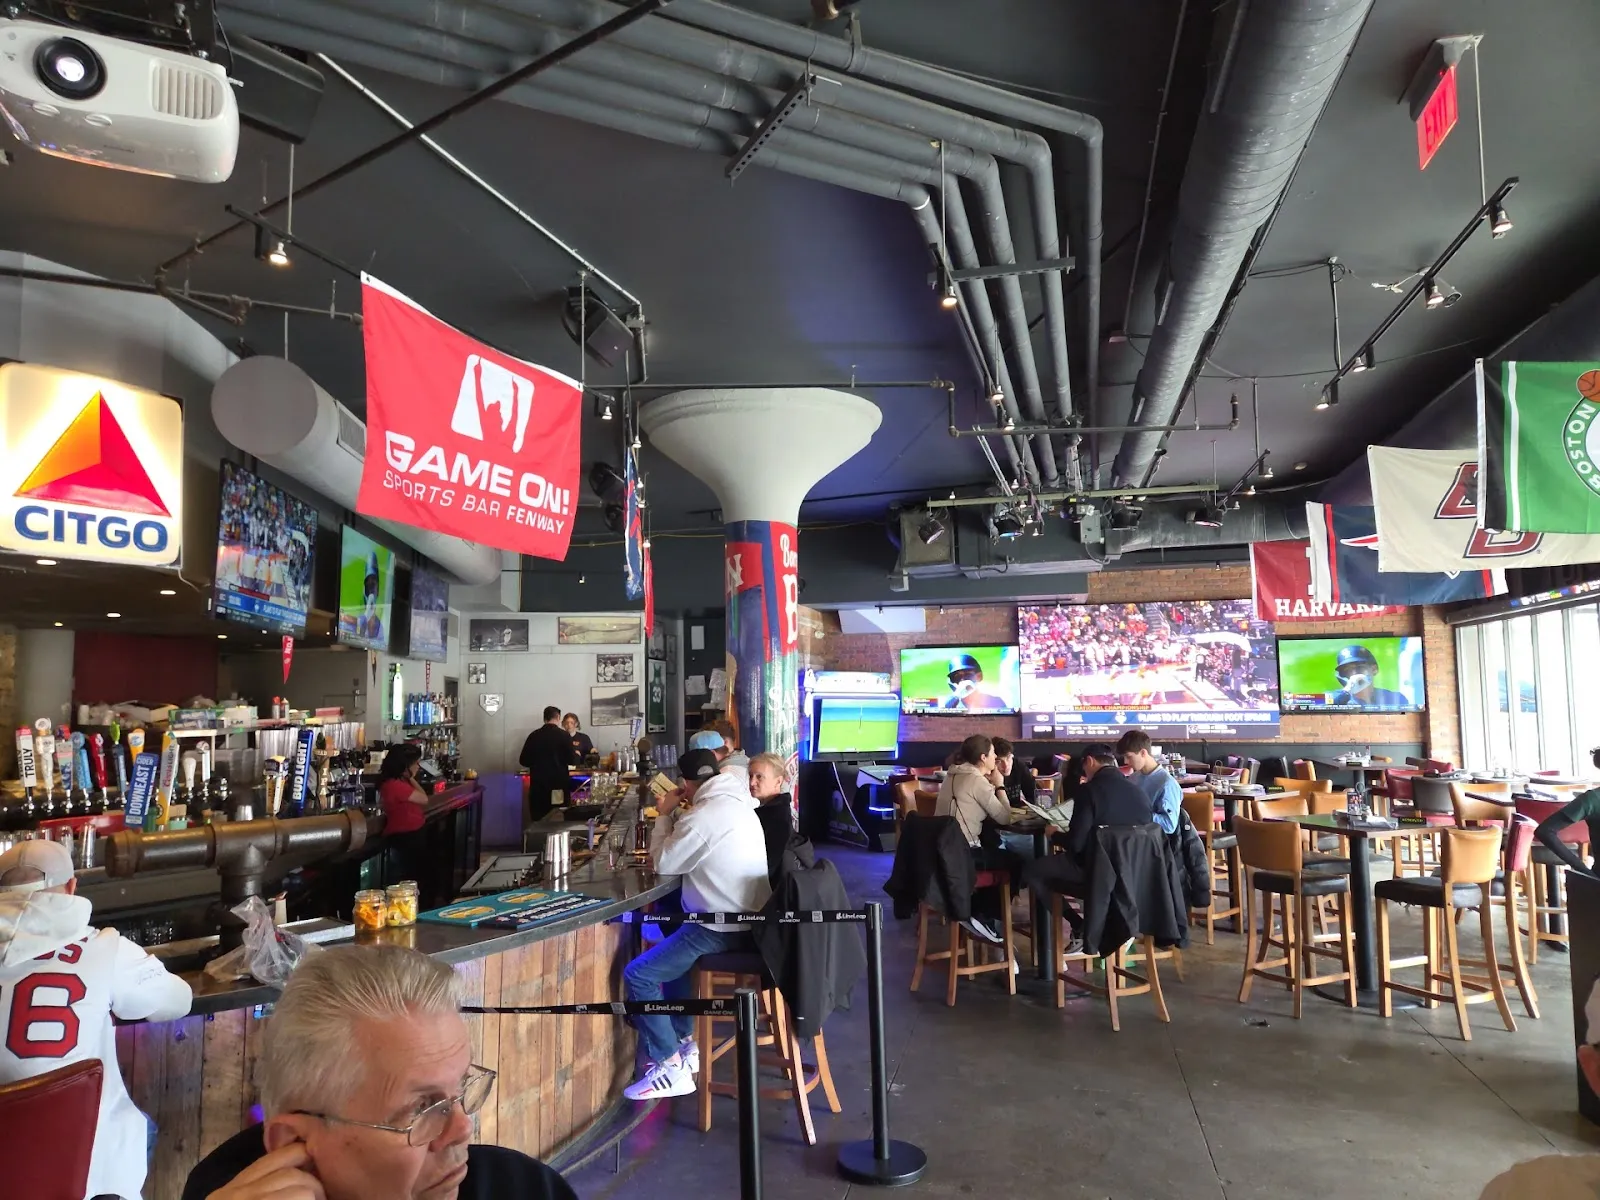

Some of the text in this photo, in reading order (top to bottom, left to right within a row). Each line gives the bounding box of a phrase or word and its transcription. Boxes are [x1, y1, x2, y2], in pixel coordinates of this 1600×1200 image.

[1423, 87, 1448, 153] EXIT
[385, 430, 570, 515] GAME ON!
[1567, 403, 1600, 490] BOSTON
[14, 505, 168, 553] CITGO
[383, 469, 565, 535] SPORTS BAR FENWAY
[22, 748, 35, 778] TRULY
[129, 765, 150, 815] DOWNEAST
[292, 741, 308, 800] BUD LIGHT
[653, 1004, 685, 1012] LineLeap
